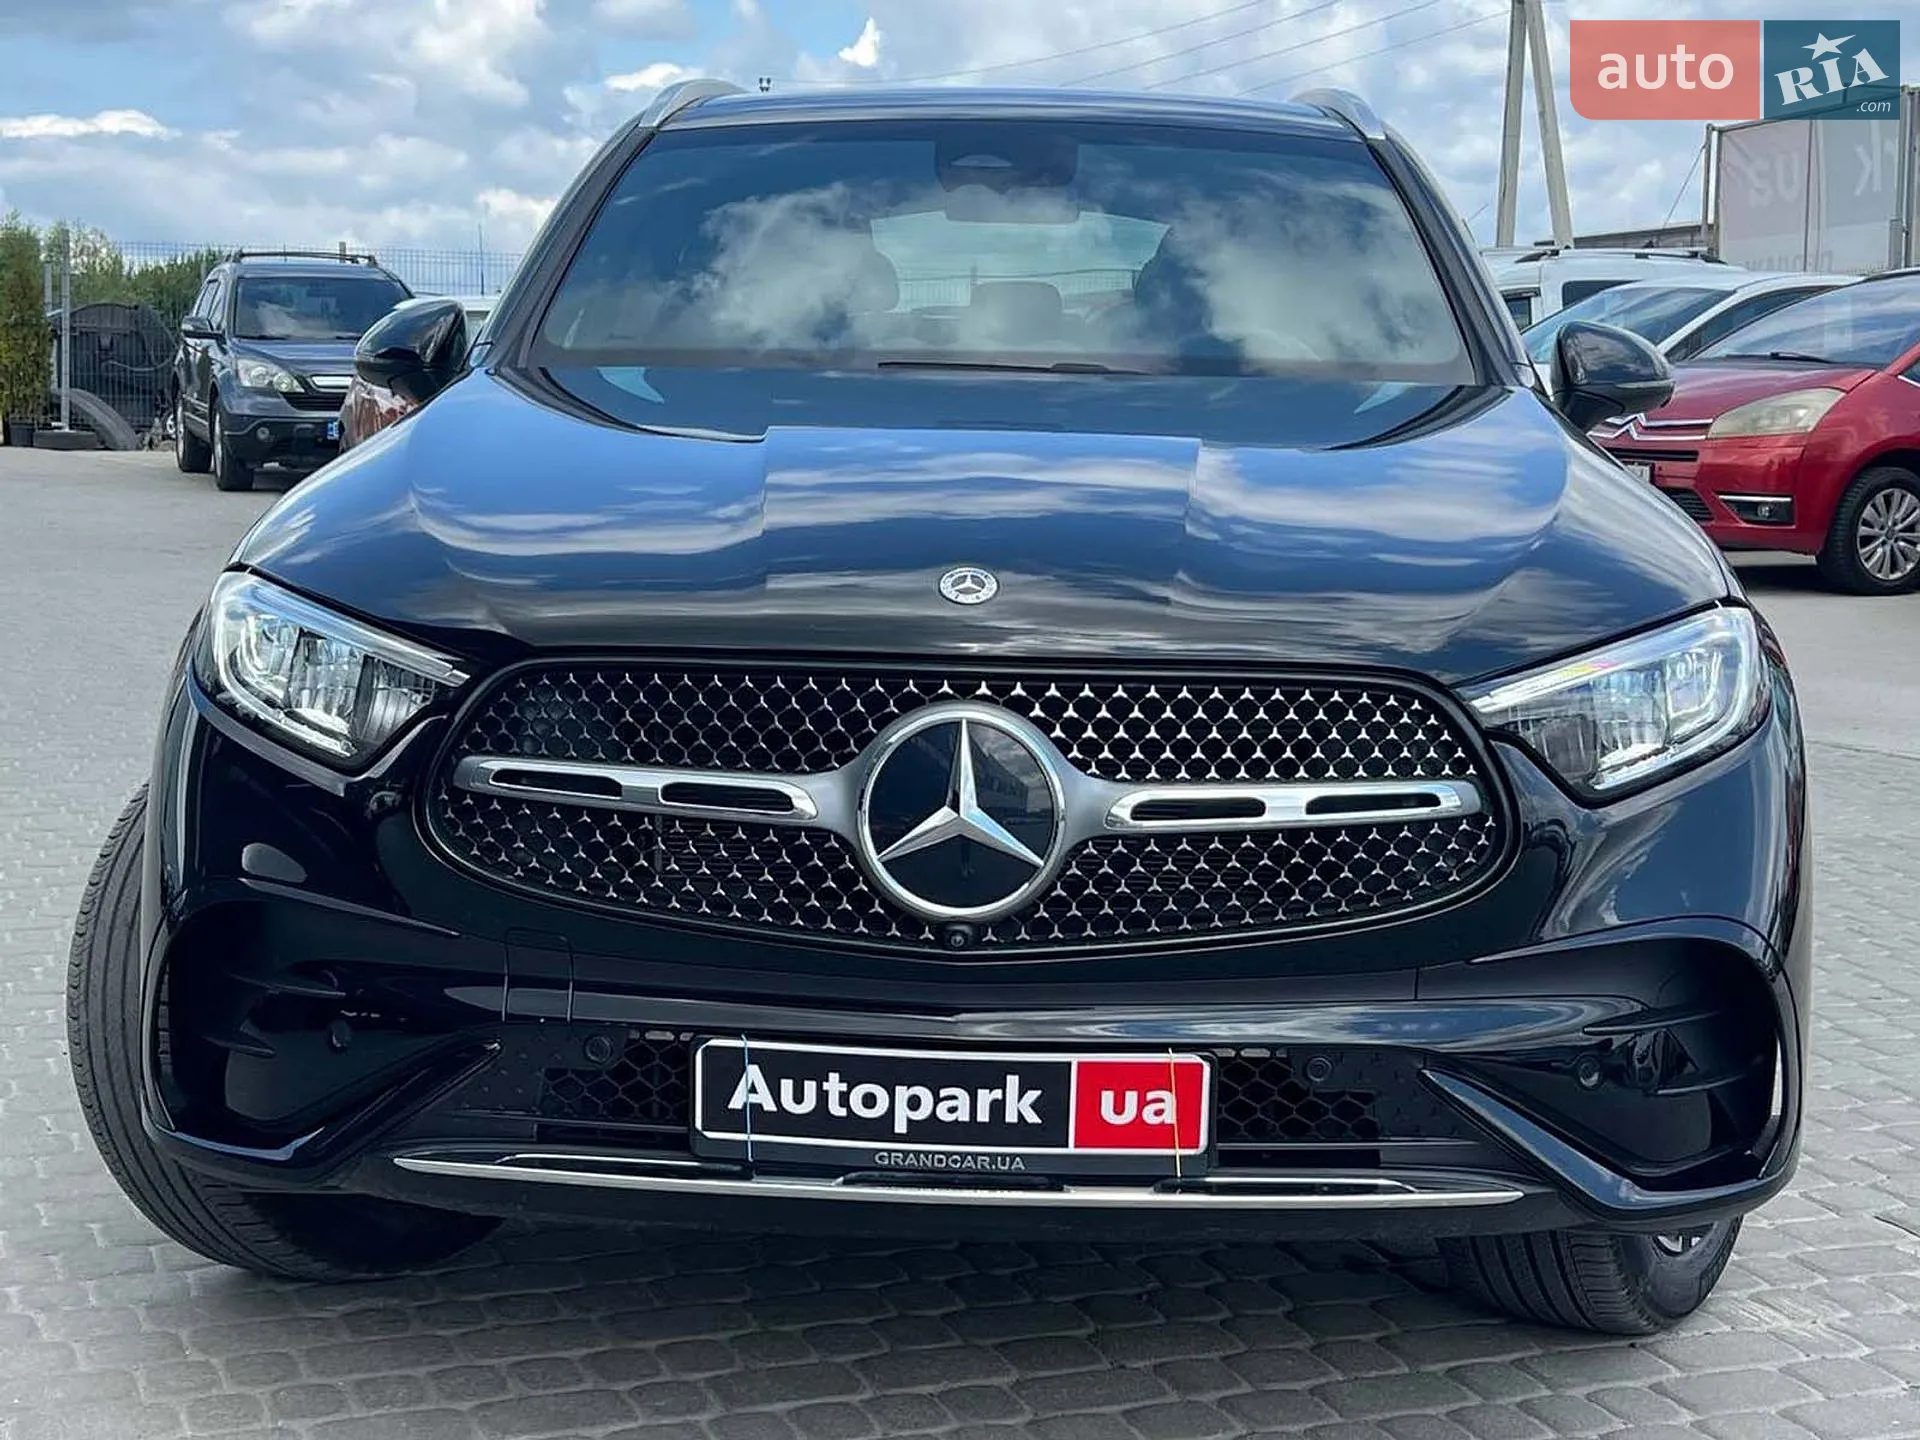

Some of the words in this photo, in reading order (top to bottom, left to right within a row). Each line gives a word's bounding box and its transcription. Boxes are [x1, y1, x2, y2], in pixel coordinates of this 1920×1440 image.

[728, 1063, 1042, 1134] Autopark
[1099, 1088, 1177, 1126] ua
[874, 1150, 1026, 1171] GRANDCAR.UA
